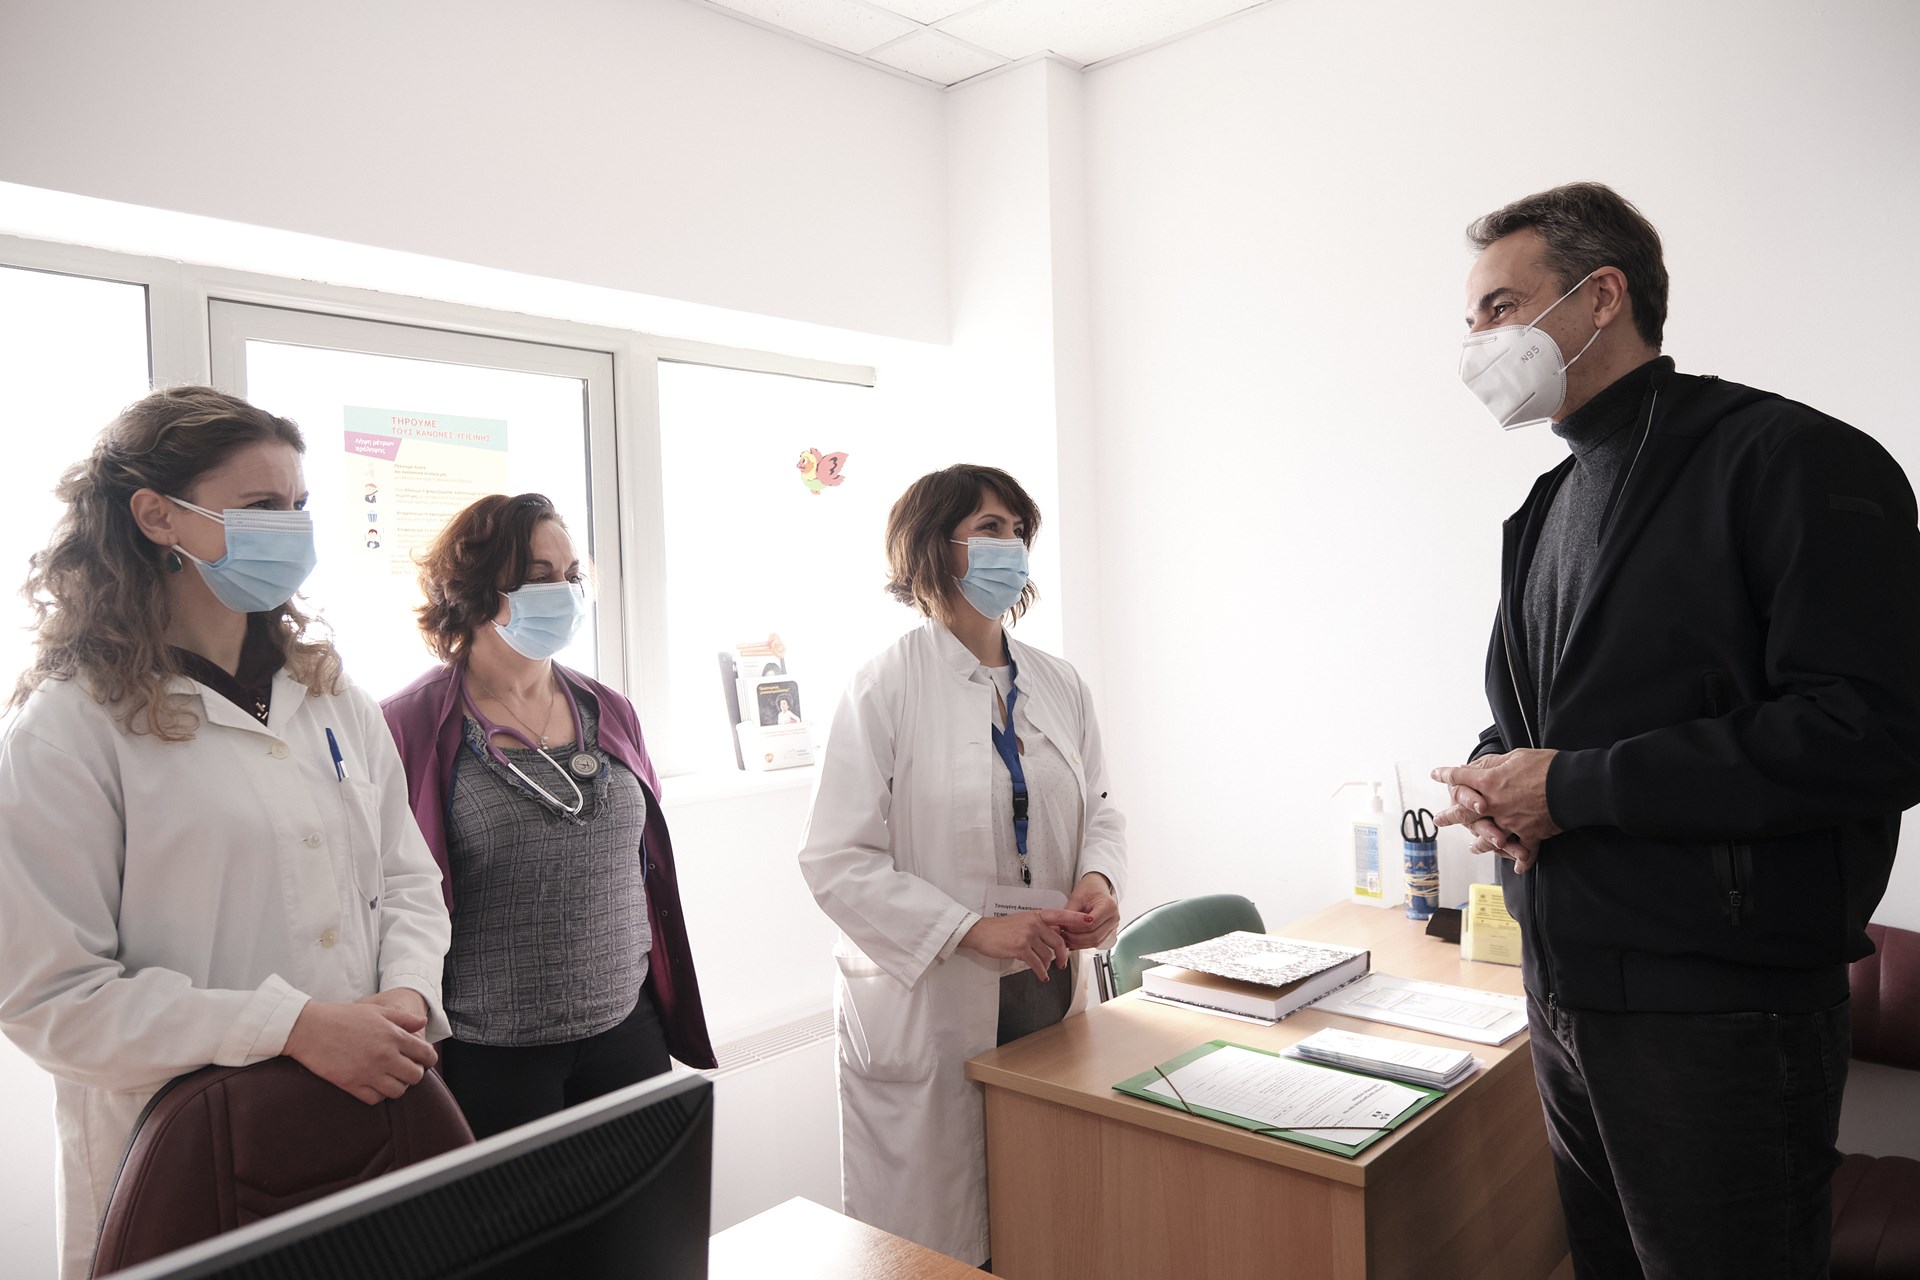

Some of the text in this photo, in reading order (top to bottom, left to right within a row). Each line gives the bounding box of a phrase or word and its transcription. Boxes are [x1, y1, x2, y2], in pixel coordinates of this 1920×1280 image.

[1521, 345, 1540, 363] N95
[391, 416, 437, 429] ΤΗΡΟΥΜΕ
[392, 427, 491, 442] ΤΟΥΣ ΚΑΝΟΝΕΣ ΥΓΙΕΙΝΗΣ
